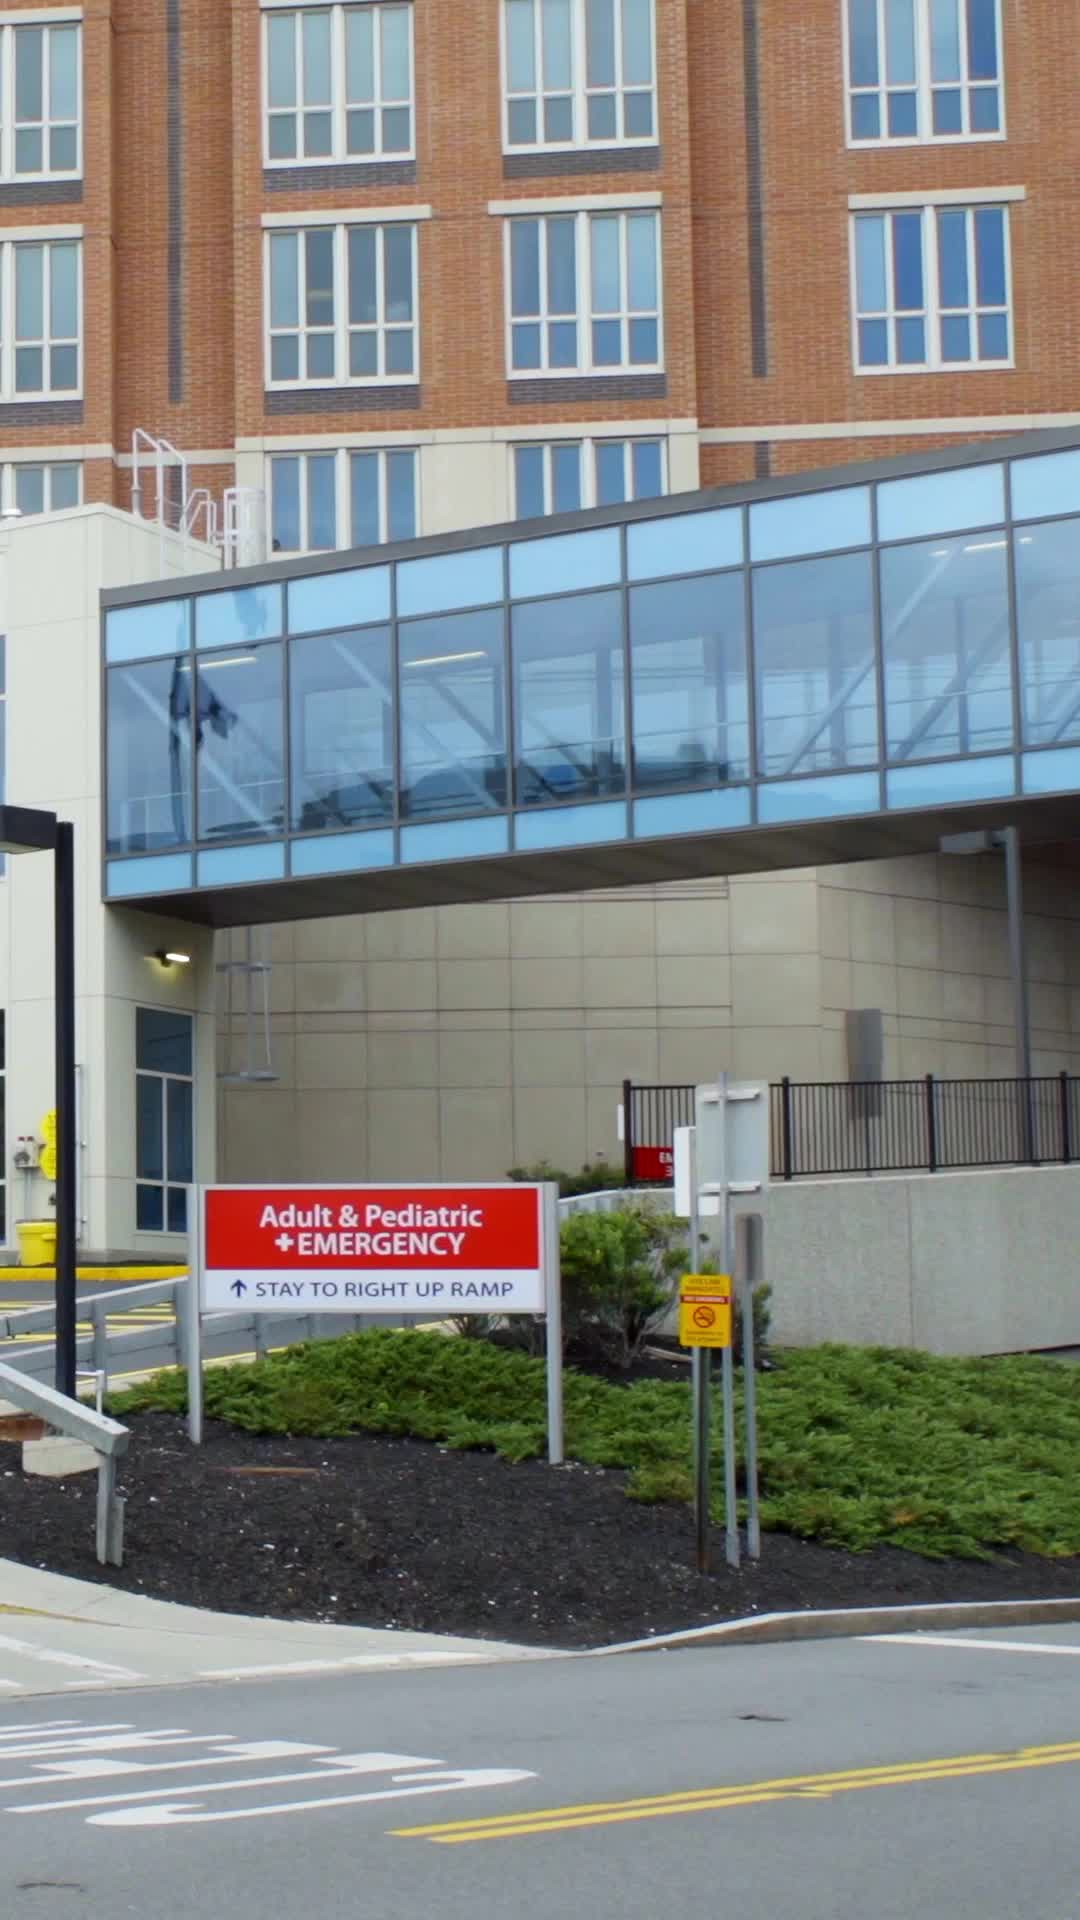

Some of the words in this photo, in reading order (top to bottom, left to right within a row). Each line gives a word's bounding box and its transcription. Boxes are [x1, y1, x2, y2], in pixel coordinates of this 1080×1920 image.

[259, 1204, 332, 1228] Adult
[338, 1204, 359, 1228] &
[365, 1203, 483, 1228] Pediatric
[297, 1231, 466, 1256] EMERGENCY
[255, 1281, 304, 1298] STAY
[309, 1281, 339, 1298] TO
[344, 1281, 409, 1298] RIGHT
[415, 1281, 445, 1298] UP
[450, 1281, 514, 1298] RAMP
